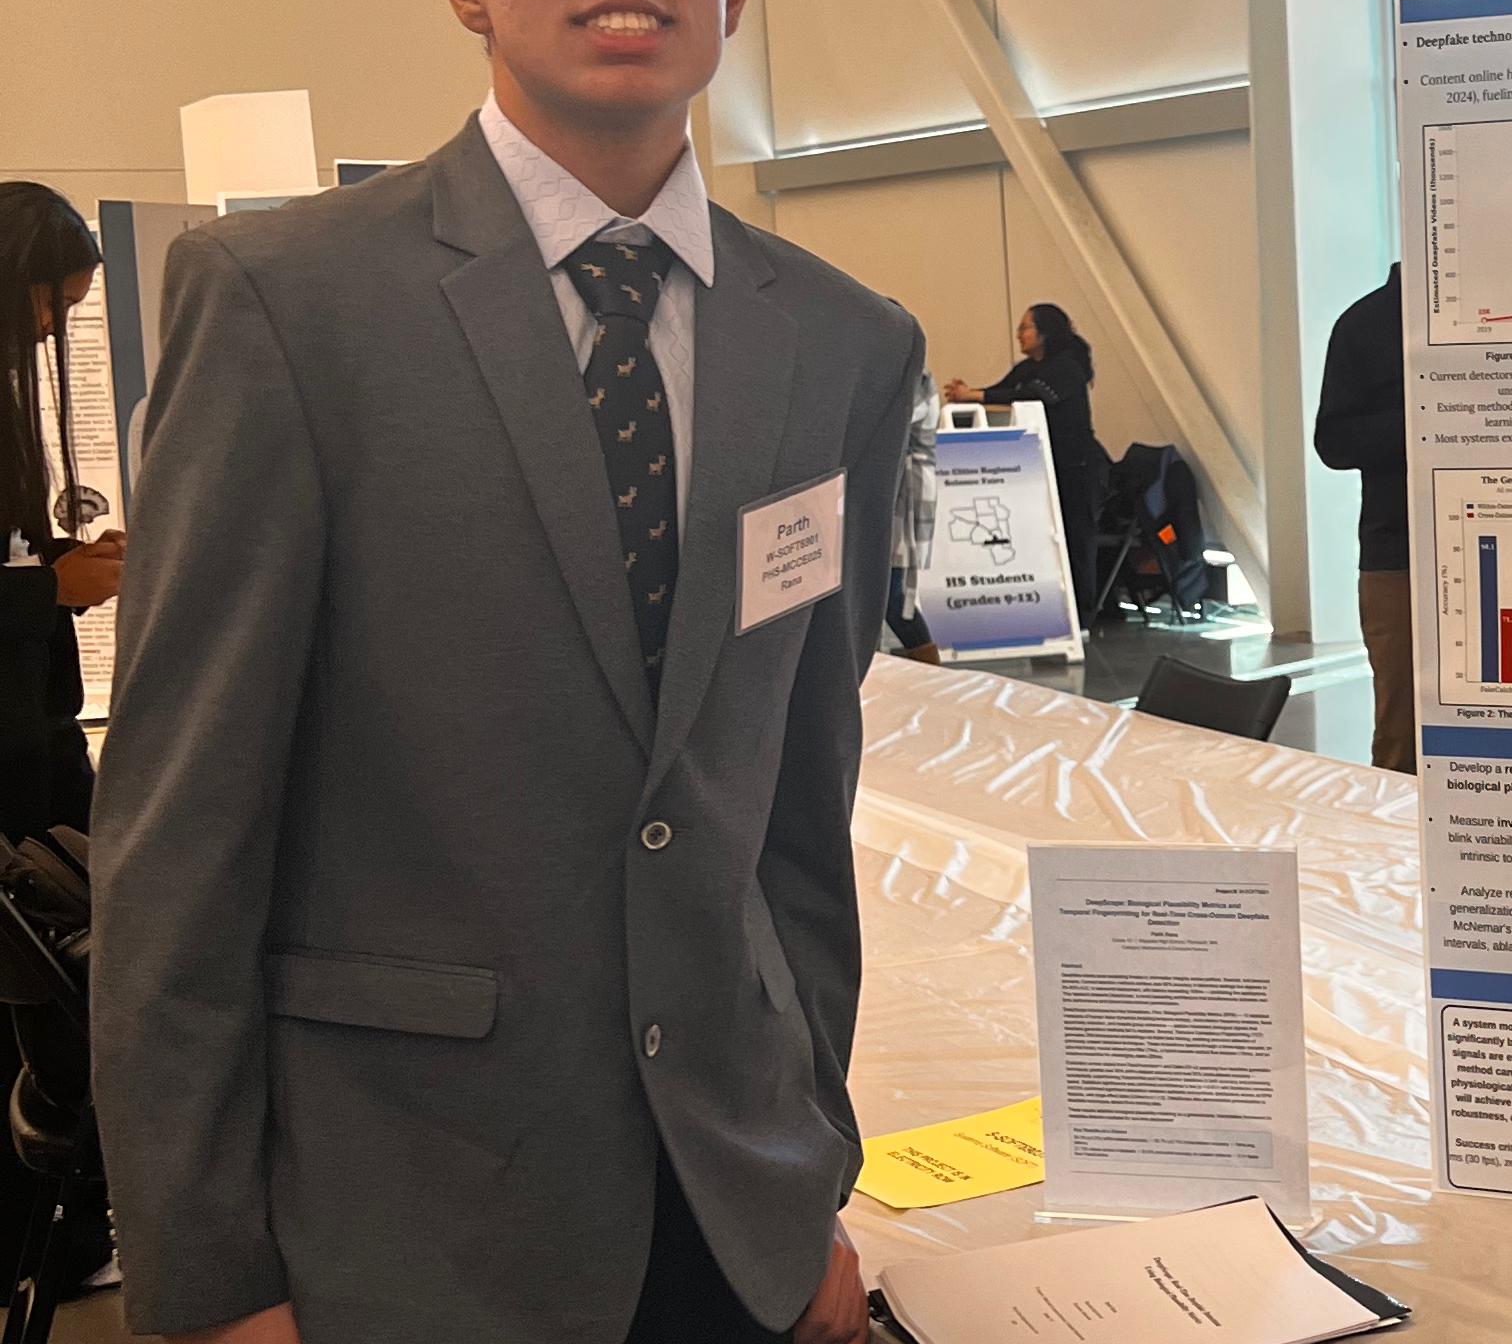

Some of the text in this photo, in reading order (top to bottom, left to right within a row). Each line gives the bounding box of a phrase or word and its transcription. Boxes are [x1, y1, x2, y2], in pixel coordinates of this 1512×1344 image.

[1416, 33, 1470, 51] Deepfake
[1420, 72, 1466, 87] Content
[1468, 69, 1504, 83] online
[1446, 90, 1480, 105] 2024),
[1429, 370, 1467, 383] Current
[777, 516, 810, 539] Parth
[970, 574, 1034, 586] Students
[946, 594, 1000, 608] (grades
[1449, 761, 1493, 776] Develop
[1494, 765, 1503, 774] a
[1446, 778, 1502, 794] biological
